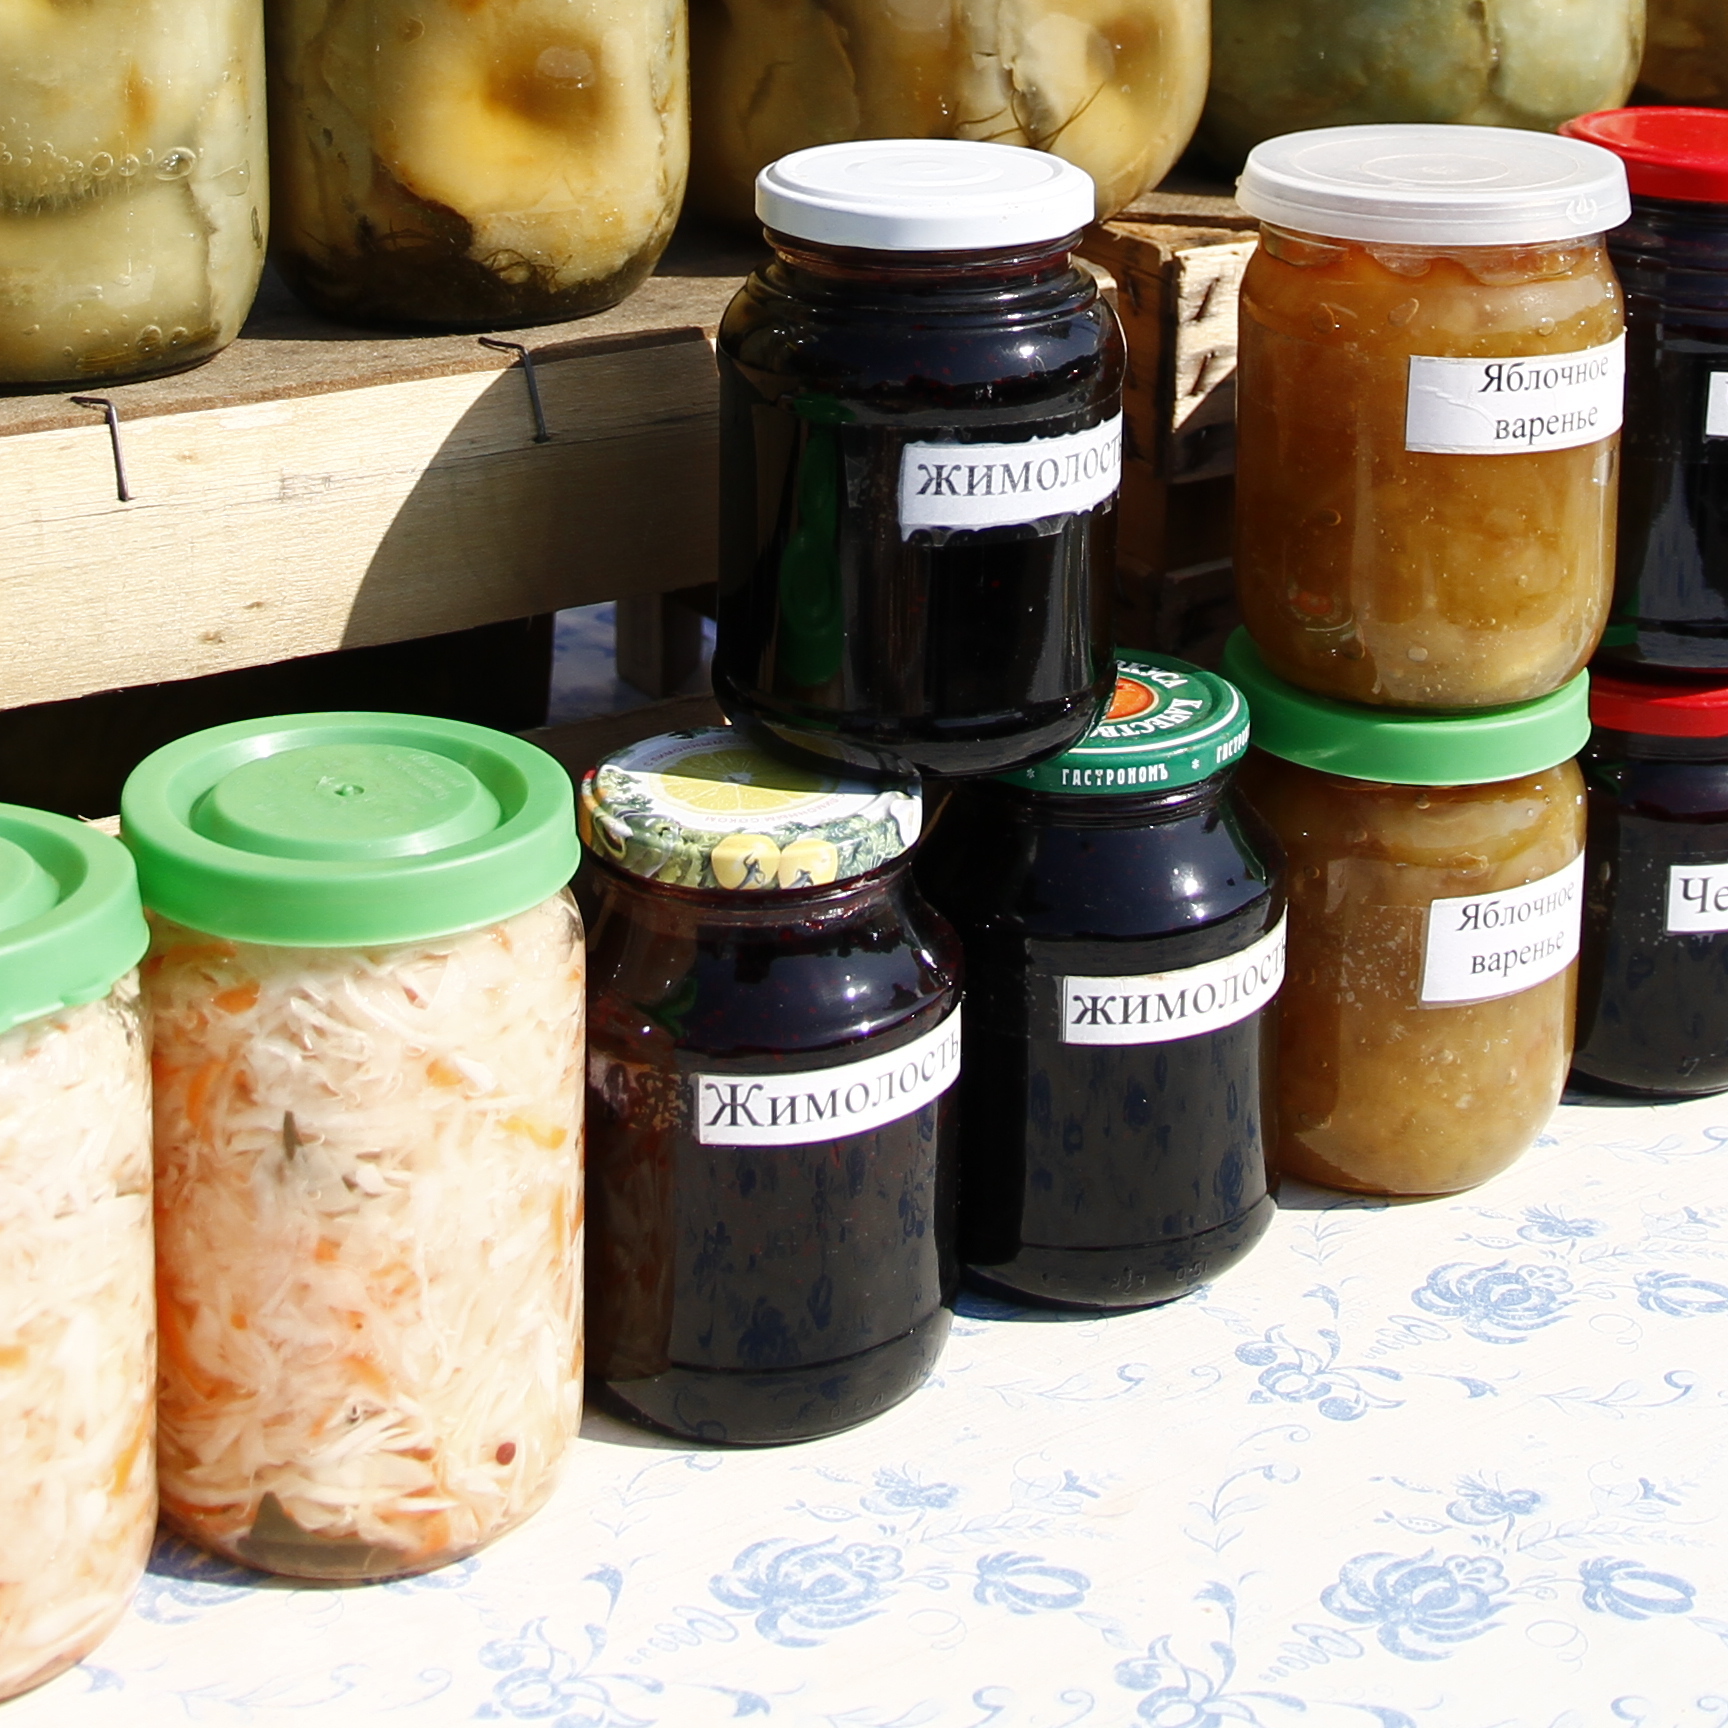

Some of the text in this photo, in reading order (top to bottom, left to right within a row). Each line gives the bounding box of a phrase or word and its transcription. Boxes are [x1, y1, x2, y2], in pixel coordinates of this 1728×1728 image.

[1478, 356, 1609, 393] Яблочное
[1494, 406, 1598, 446] варенье
[1062, 763, 1169, 786] ГАСТРОНОМЪ
[1456, 882, 1575, 931] Яблочное
[1470, 931, 1565, 978] варенье
[704, 1030, 960, 1127] Жимолость
